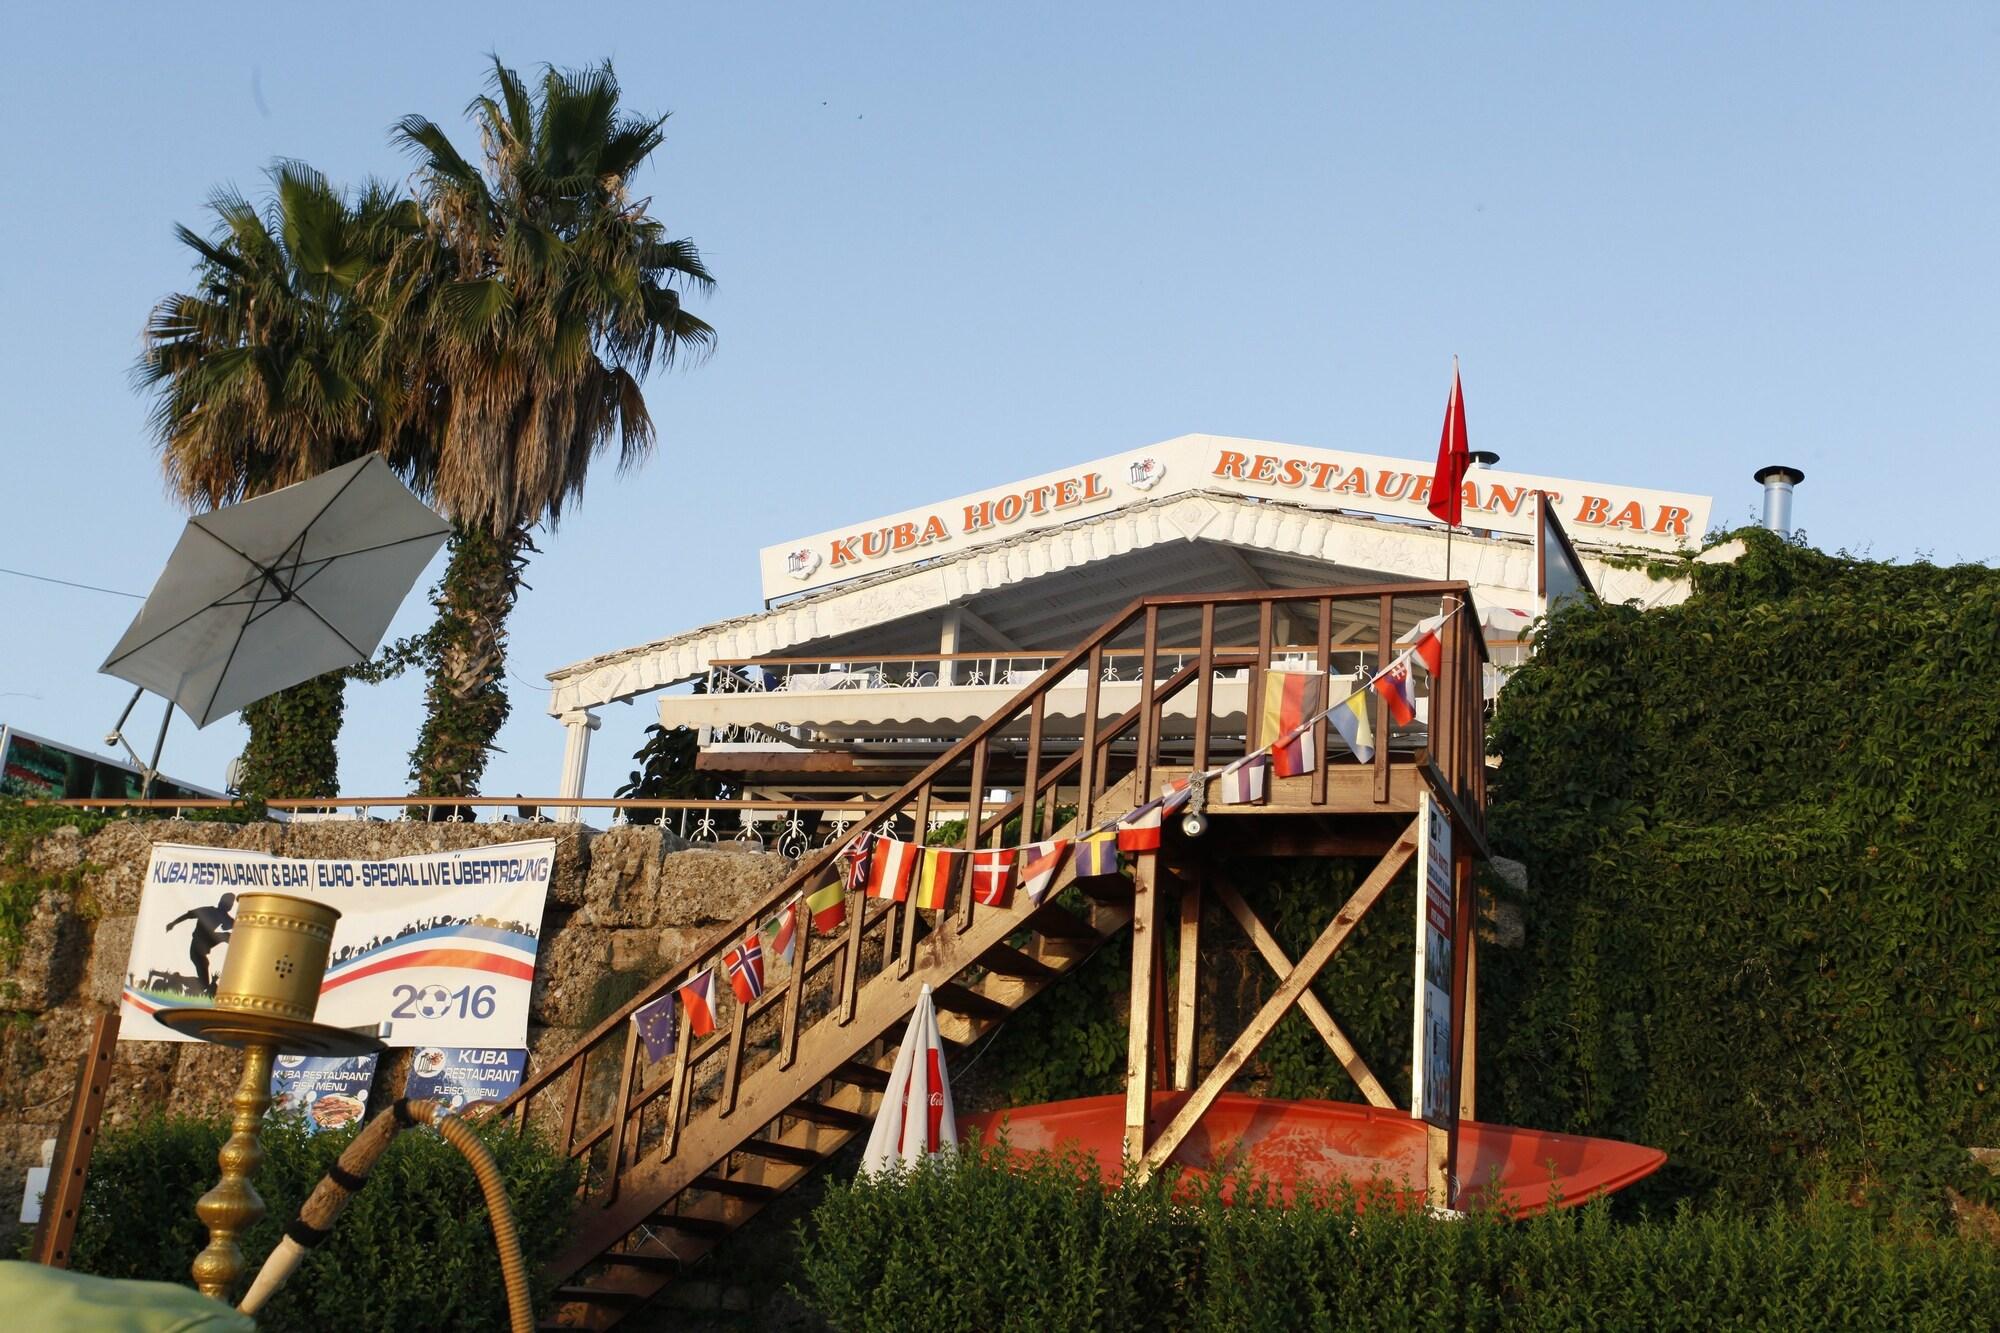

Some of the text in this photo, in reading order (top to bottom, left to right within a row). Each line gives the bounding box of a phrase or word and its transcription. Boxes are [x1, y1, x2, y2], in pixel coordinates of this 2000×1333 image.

[830, 473, 1109, 567] KUBA HOTEL
[1573, 495, 1692, 538] BAR
[153, 861, 188, 885] KUBA
[190, 862, 268, 887] RESTAURANT
[271, 864, 281, 887] &
[282, 864, 309, 887] BAR
[318, 863, 353, 888] EURO
[362, 862, 419, 887] SPECIAL
[420, 862, 450, 886] LIVE
[458, 1050, 508, 1065] KUBA
[302, 1070, 371, 1081] RESTAURANT
[444, 1067, 519, 1082] RESTAURANT
[315, 1082, 348, 1092] MENU
[472, 1087, 499, 1097] MENU
